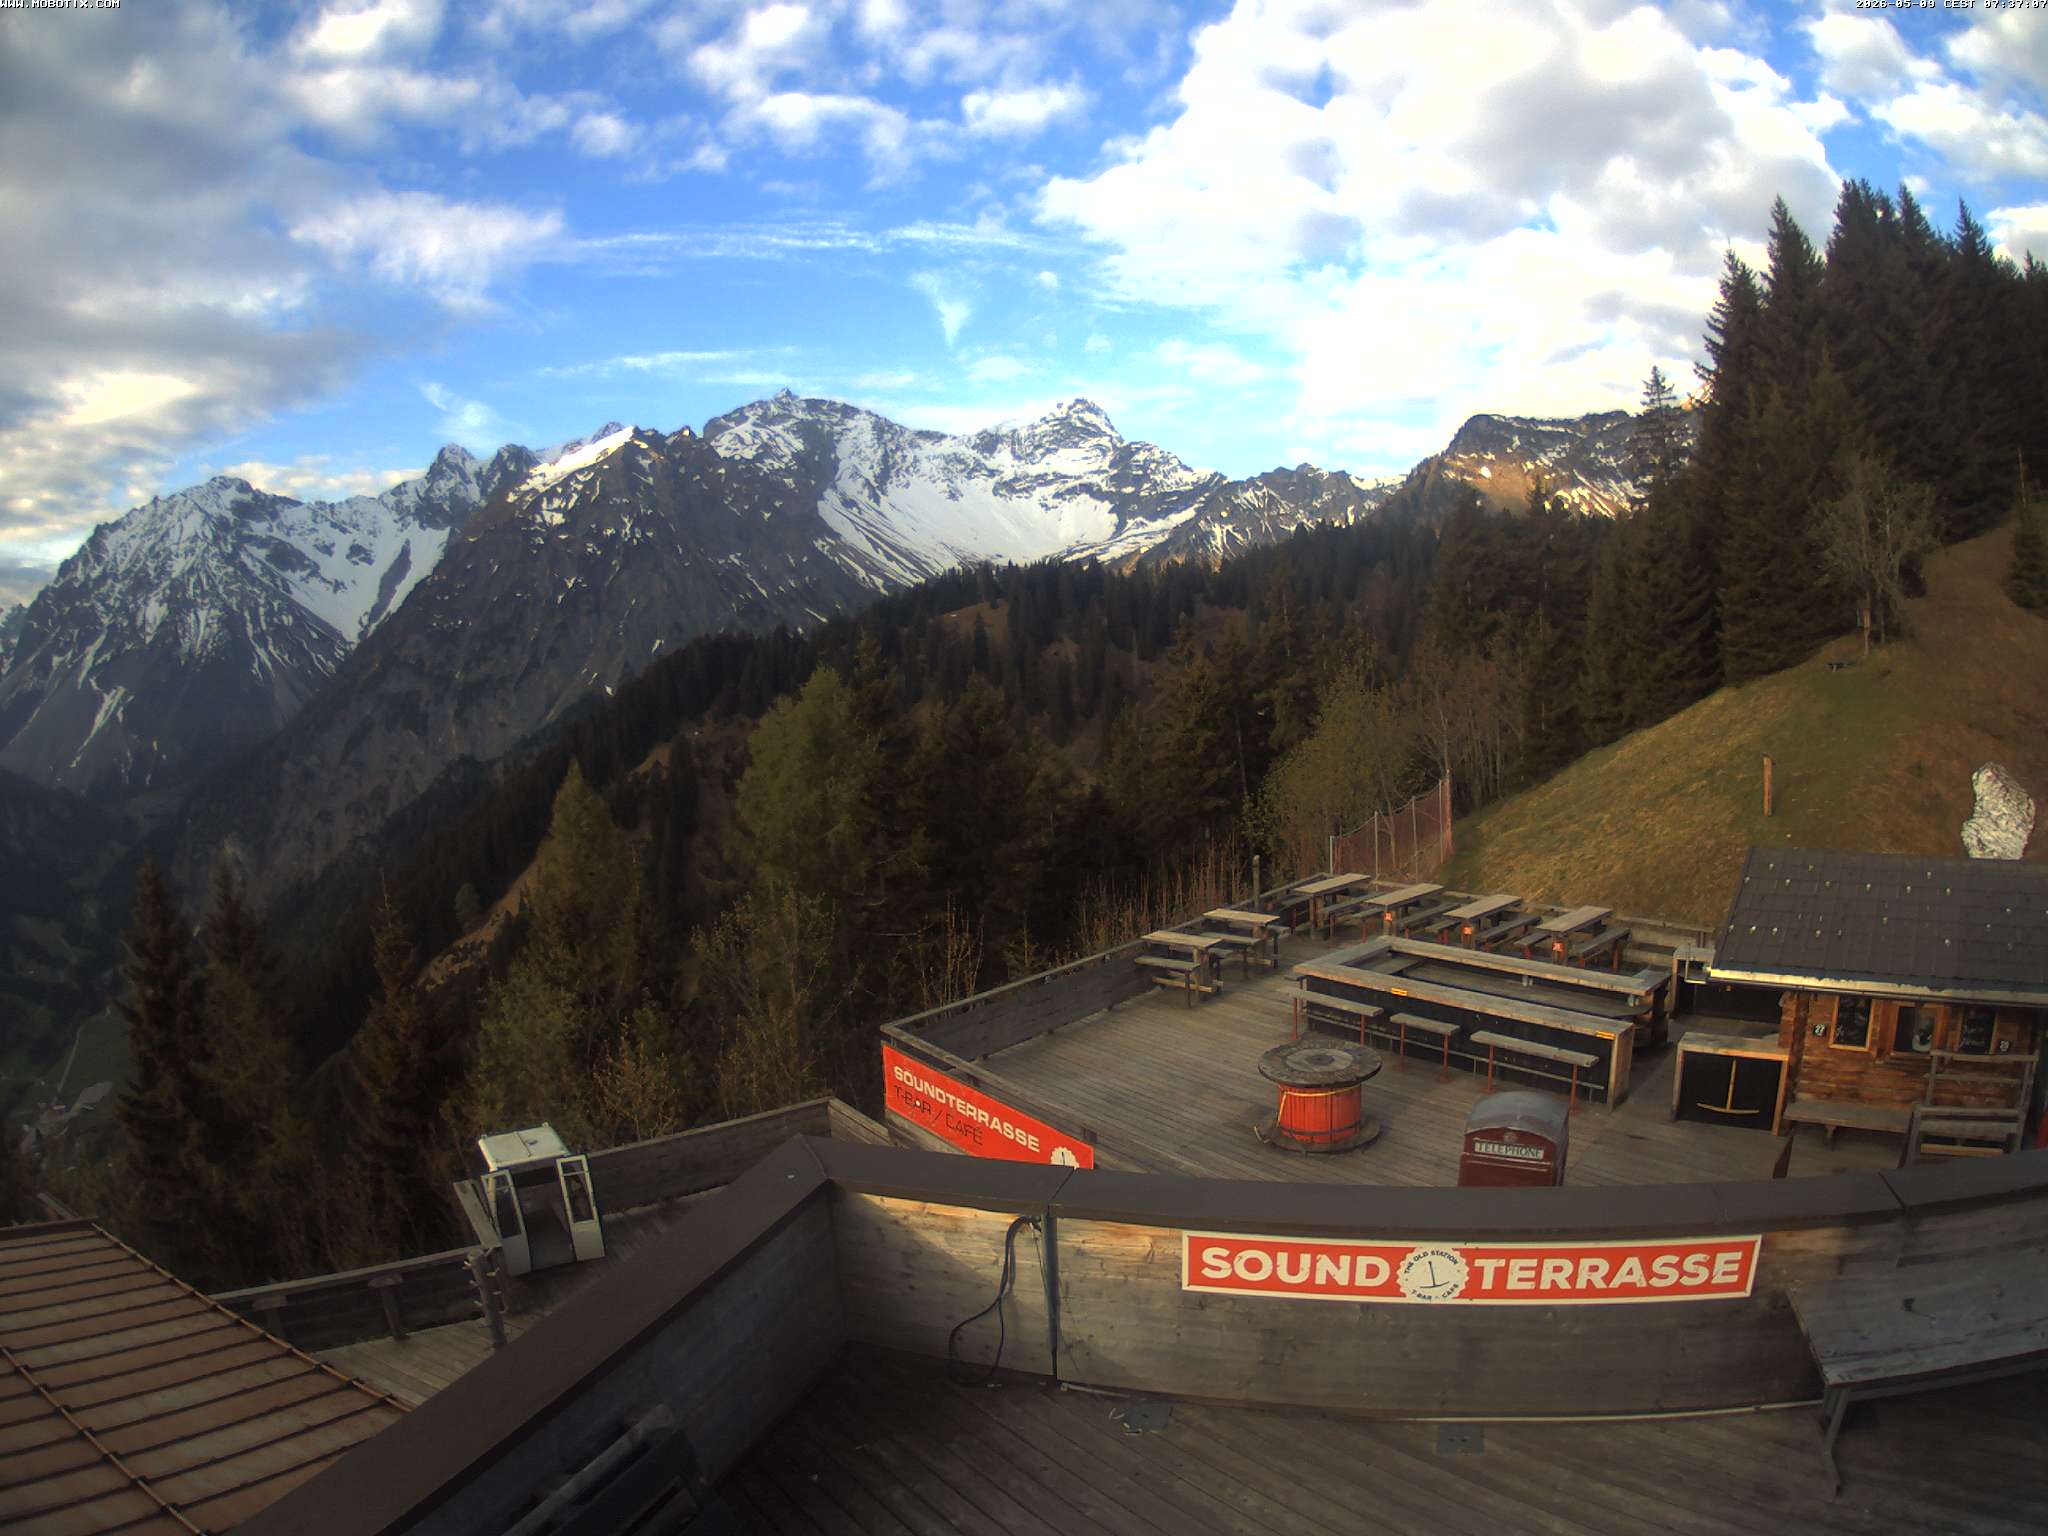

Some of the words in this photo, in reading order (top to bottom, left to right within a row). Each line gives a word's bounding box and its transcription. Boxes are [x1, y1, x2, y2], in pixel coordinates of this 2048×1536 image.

[894, 1066, 1040, 1153] SOUNDTERRASSE
[1475, 1142, 1545, 1159] TELEPHONE
[1201, 1247, 1391, 1287] SOUND
[1474, 1251, 1743, 1290] TERRASSE
[1413, 1251, 1429, 1262] OLD
[1431, 1250, 1459, 1265] STATION
